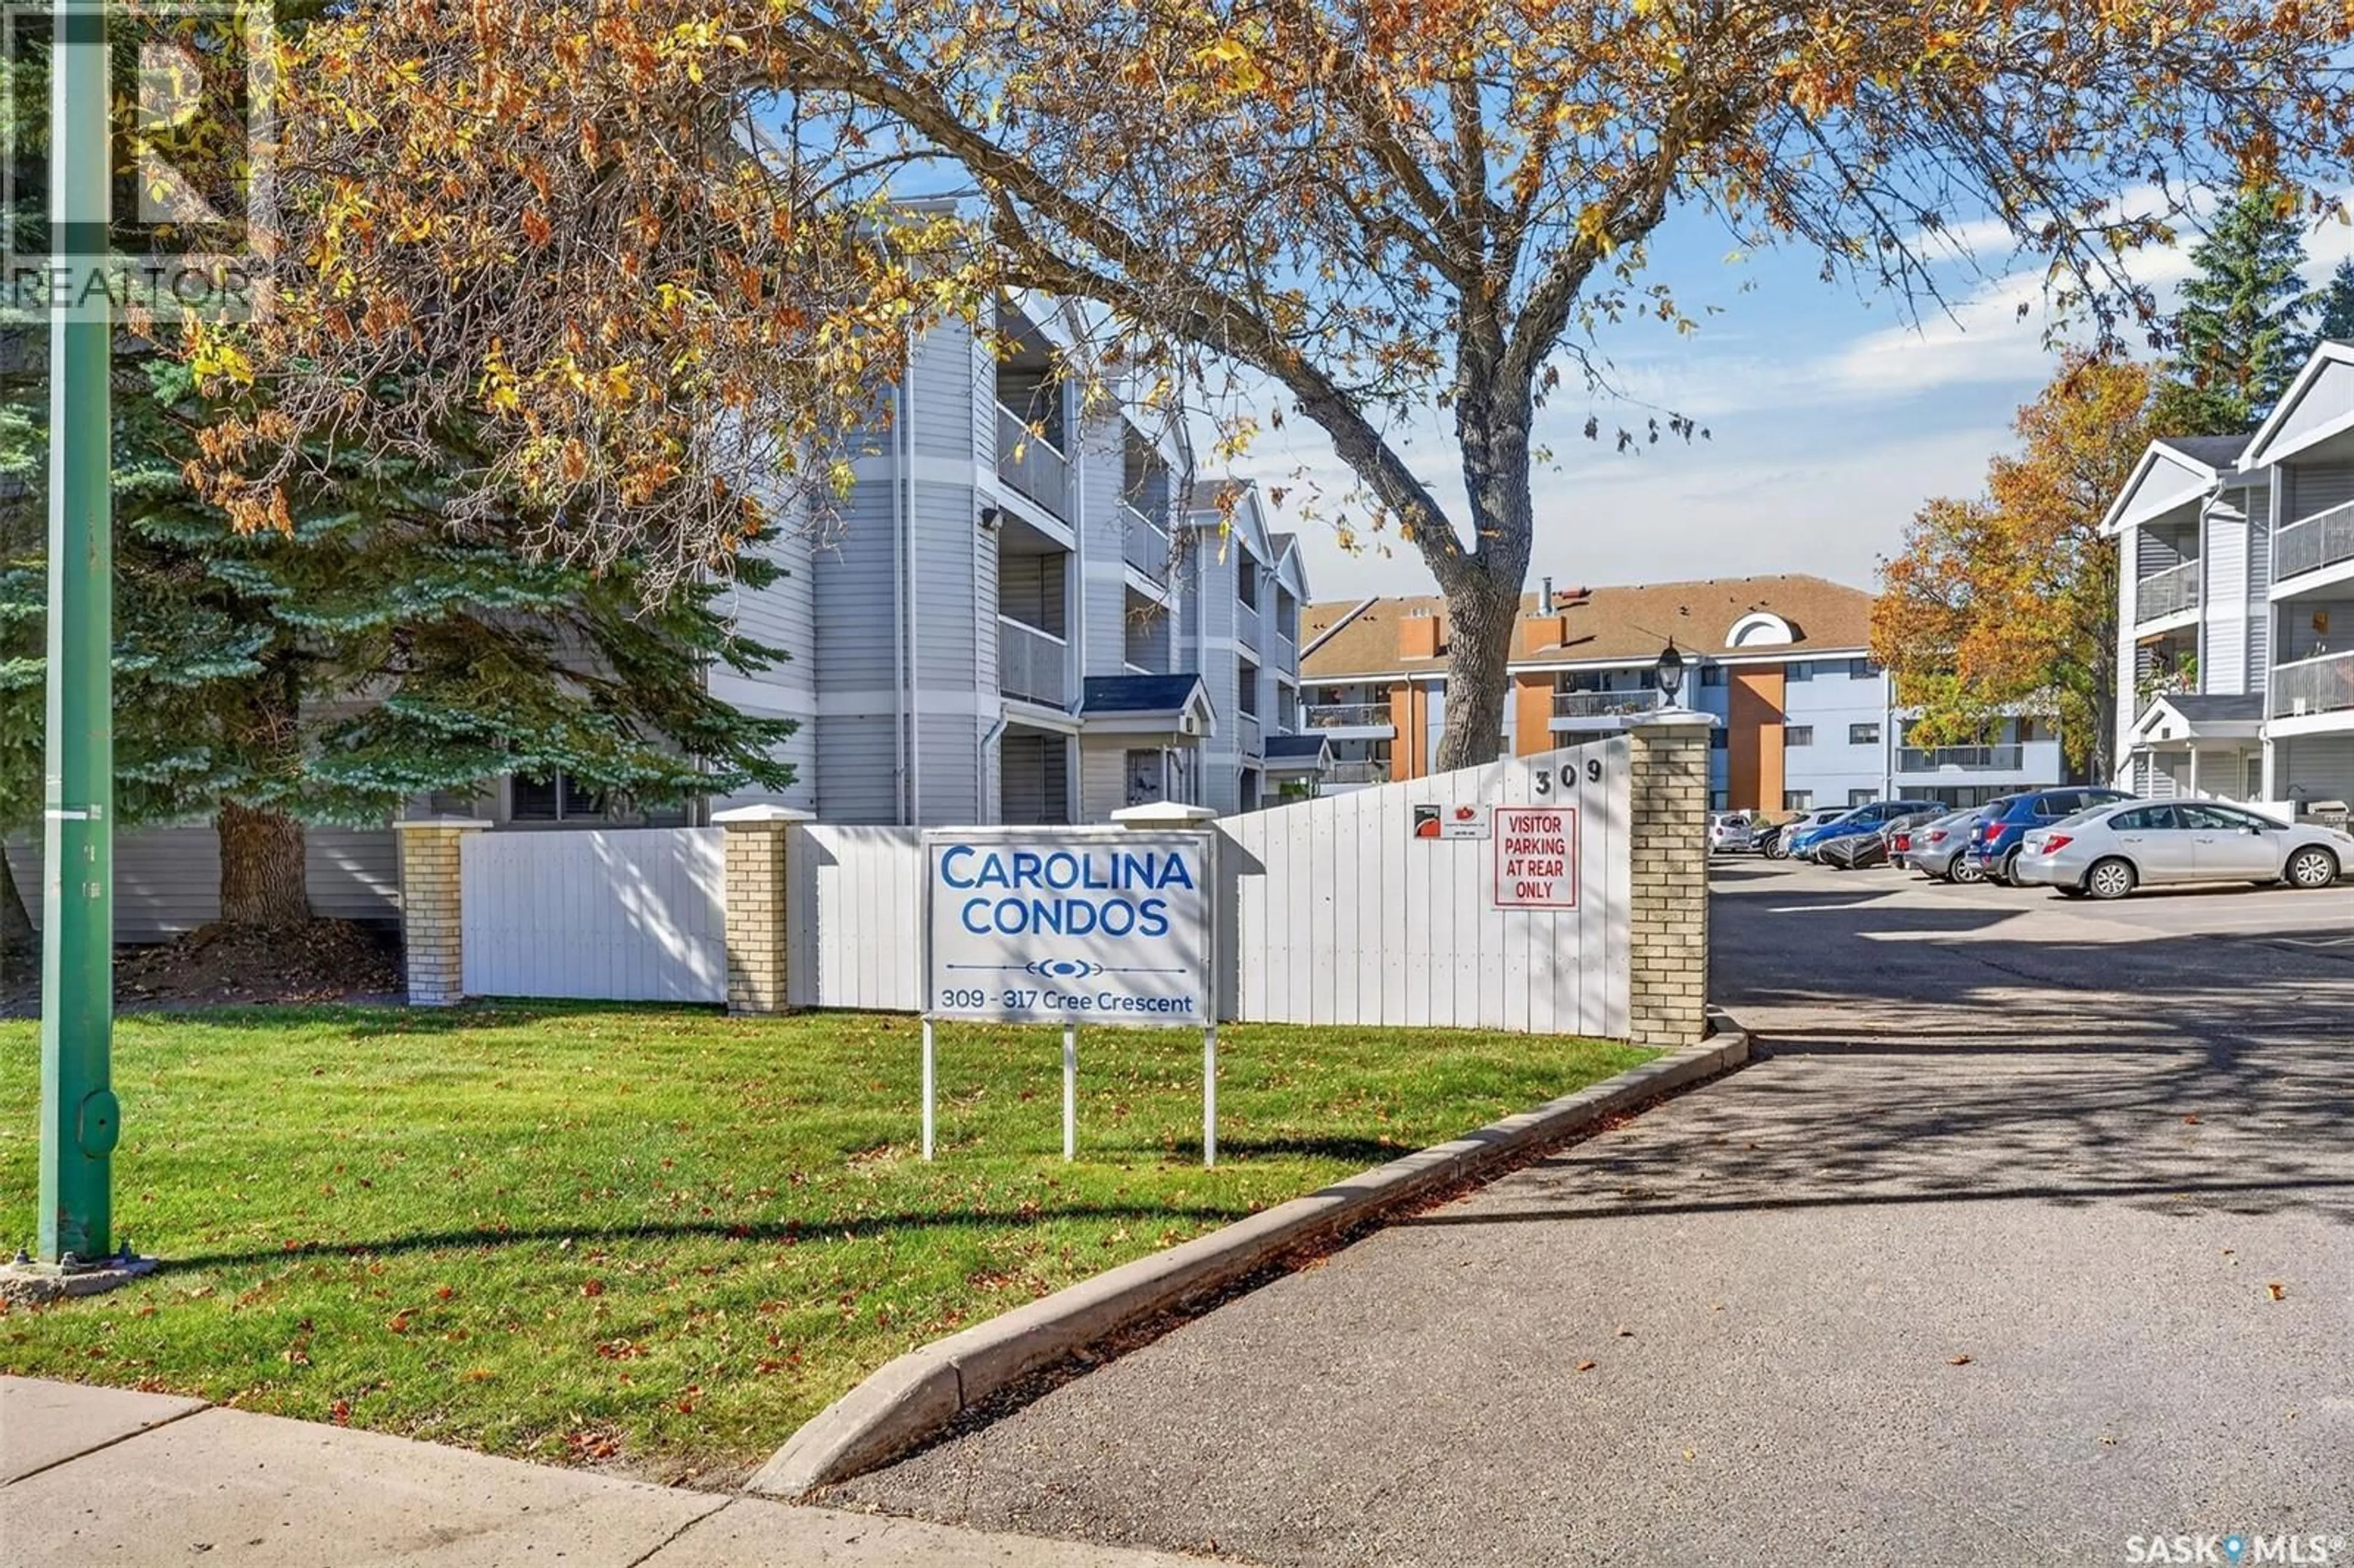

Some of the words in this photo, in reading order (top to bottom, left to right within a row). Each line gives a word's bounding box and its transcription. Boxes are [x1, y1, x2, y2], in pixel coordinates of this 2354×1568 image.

[1535, 759, 1602, 795] 309
[1508, 816, 1561, 834] VISITOR
[1504, 838, 1566, 855] PARKING
[940, 845, 1194, 890] CAROLINA
[1506, 859, 1524, 877] AT
[1528, 859, 1564, 877] REAR
[1515, 881, 1553, 899] ONLY
[961, 897, 1169, 937] CONDOS
[942, 989, 984, 1008] 309
[1002, 990, 1038, 1009] 317
[1042, 991, 1093, 1010] Cree
[1097, 992, 1193, 1013] Crescent
